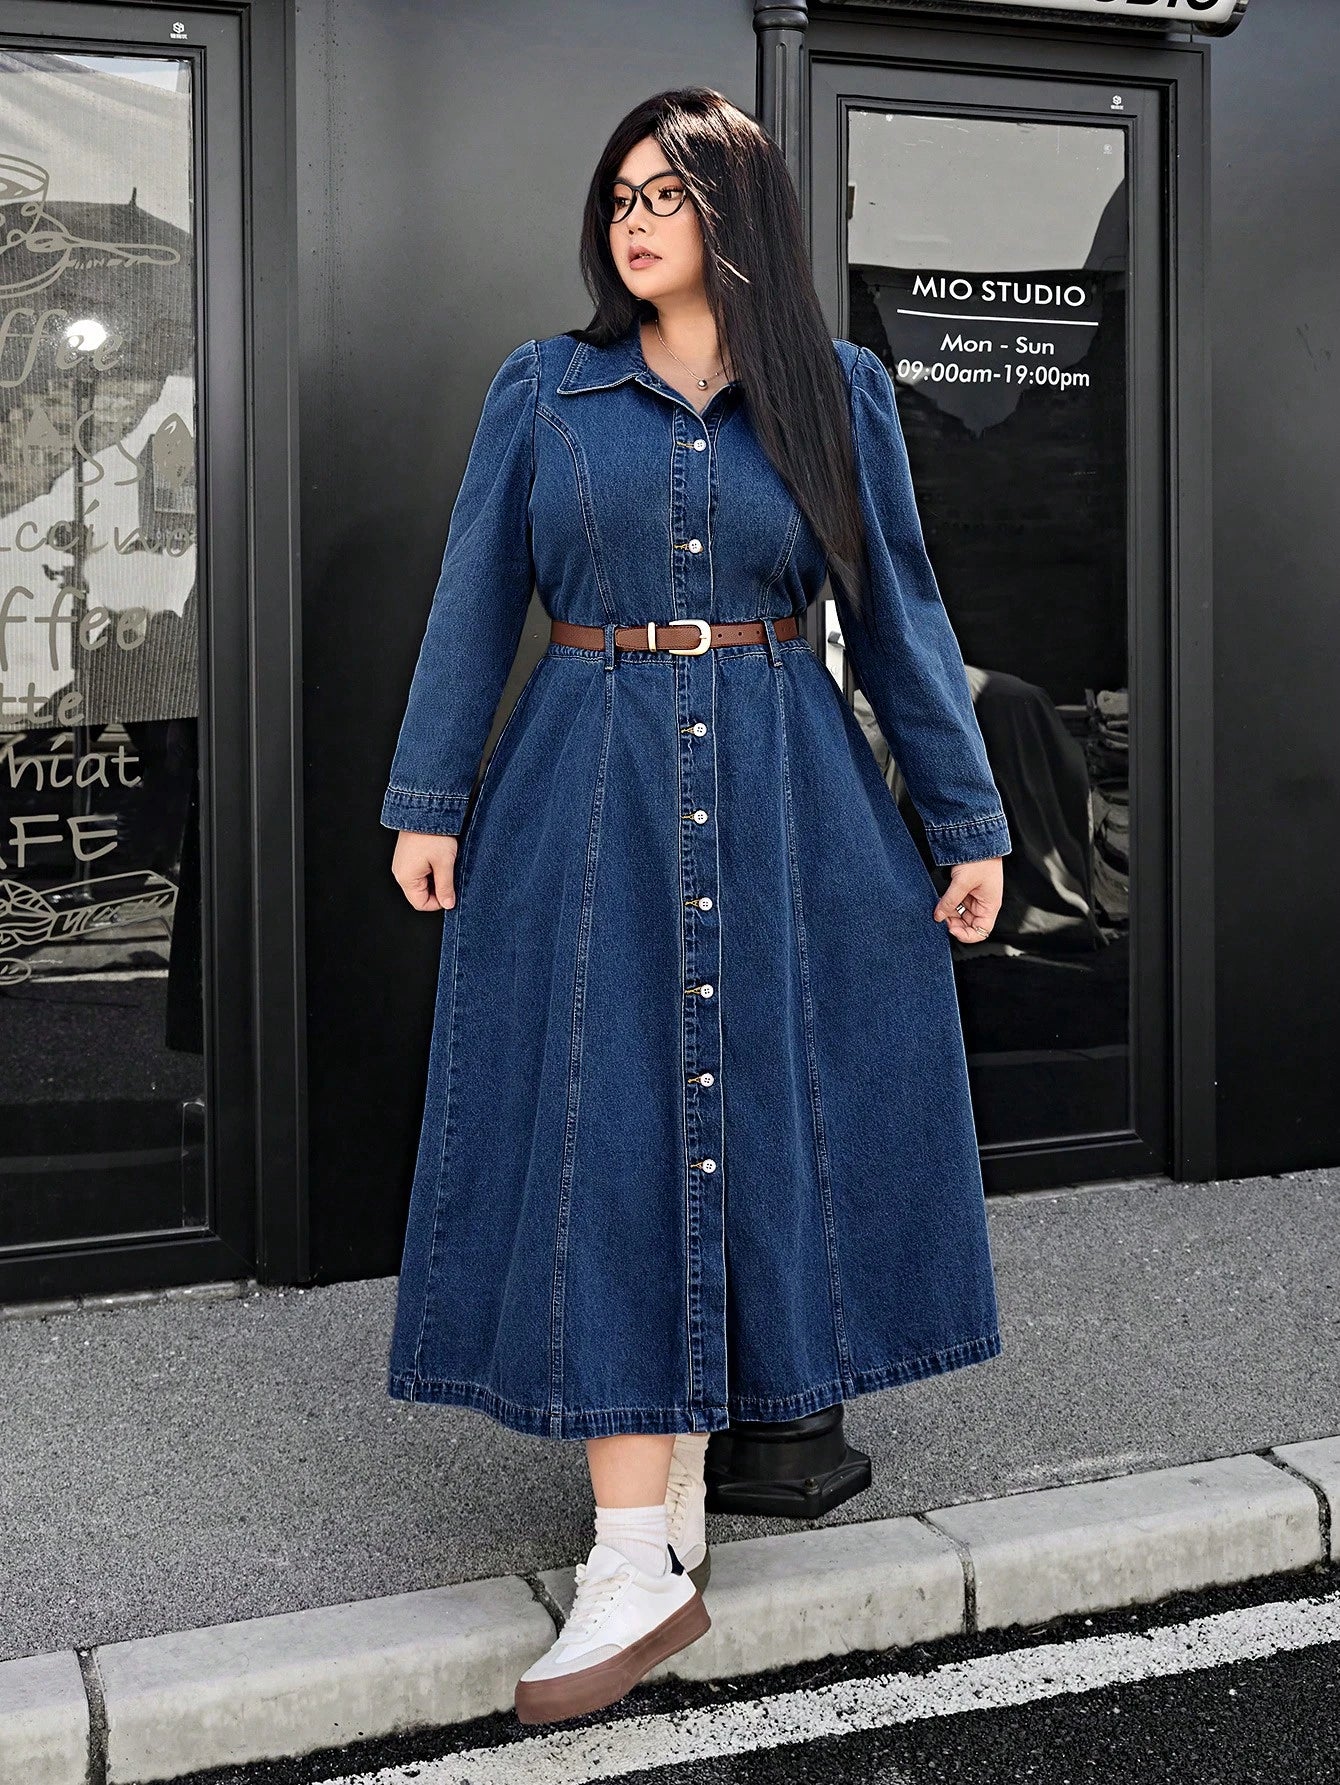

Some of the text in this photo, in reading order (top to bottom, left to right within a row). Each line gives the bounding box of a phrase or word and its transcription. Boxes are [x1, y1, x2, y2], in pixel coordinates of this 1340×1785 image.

[911, 275, 1086, 307] MIO STUDIO
[940, 333, 992, 353] Mon
[1015, 336, 1055, 355] Sun
[897, 359, 1090, 391] 09:00am-19:00pm
